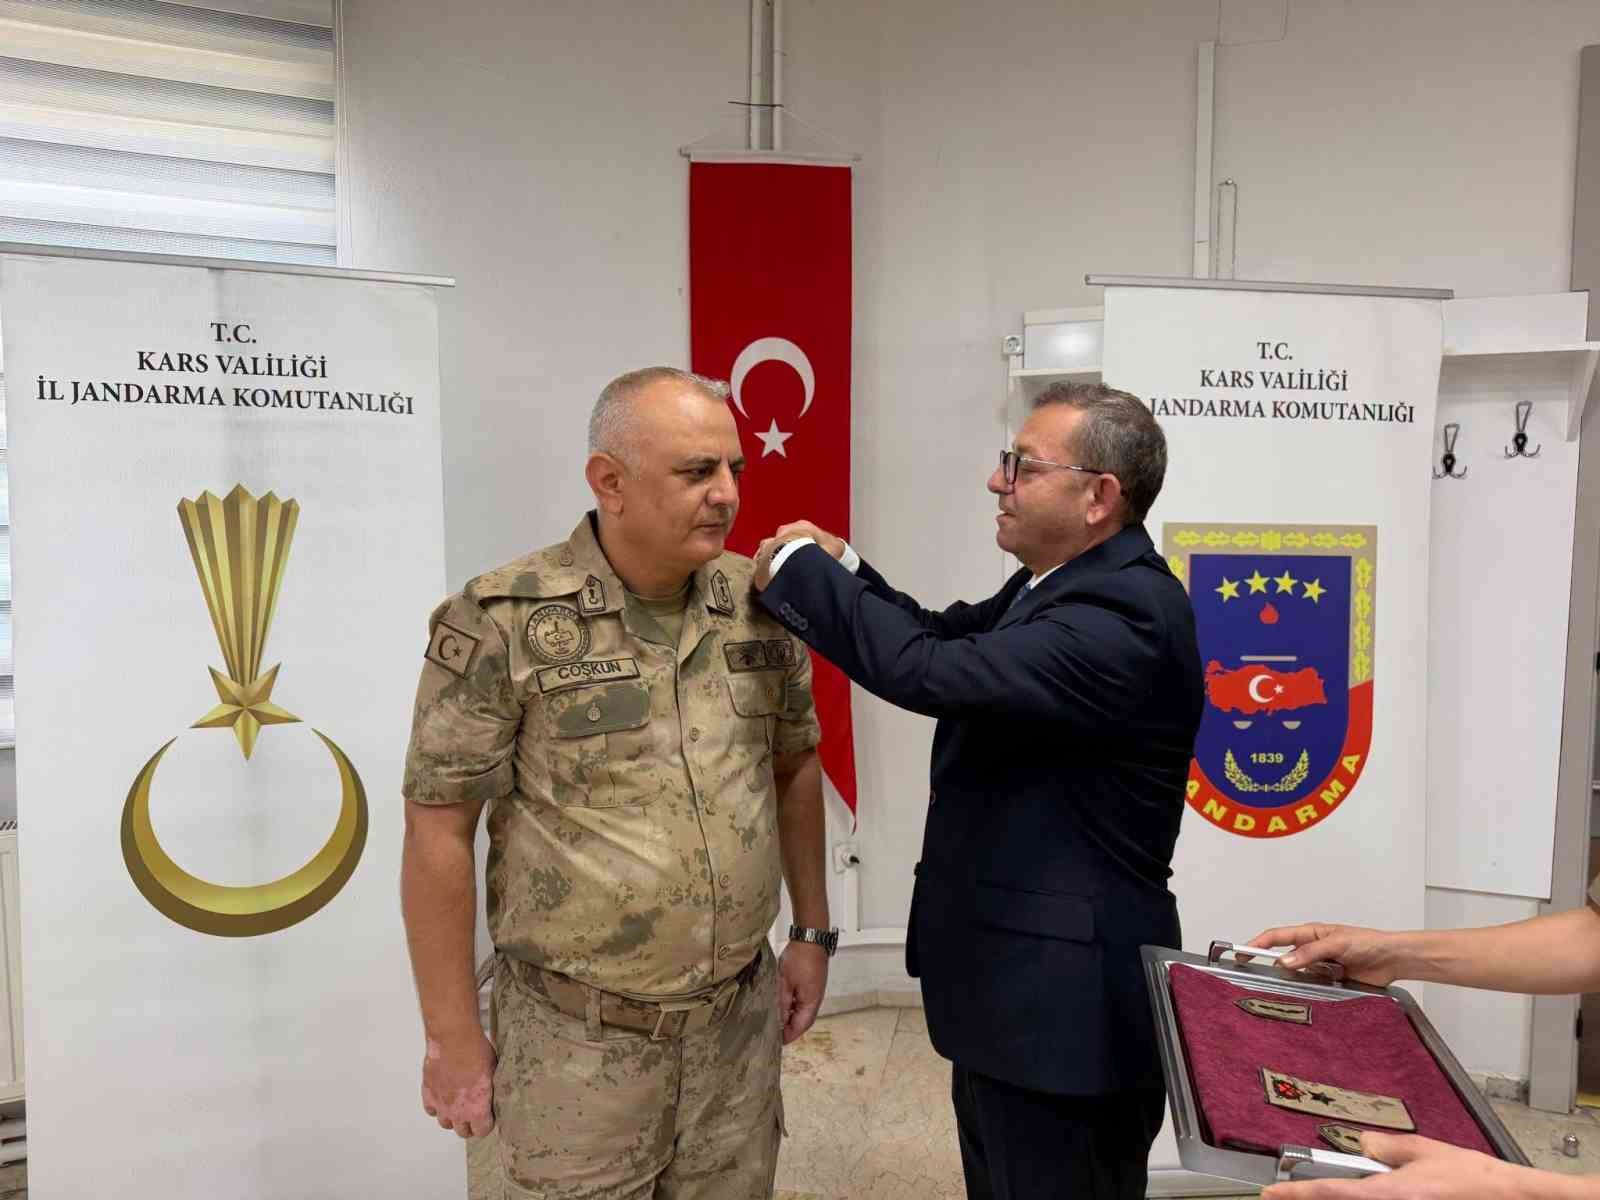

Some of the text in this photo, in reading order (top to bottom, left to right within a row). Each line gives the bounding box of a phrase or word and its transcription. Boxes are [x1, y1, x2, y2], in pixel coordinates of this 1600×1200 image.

[210, 322, 257, 344] T.C.
[1257, 342, 1293, 361] T.C.
[137, 351, 328, 379] KARS VALİLİĞİ
[1200, 368, 1349, 391] KARS VALİLİĞİ
[37, 375, 414, 415] İL JANDARMA KOMUTANLIĞI
[1150, 398, 1415, 424] JANDARMA KOMUTANLIĞI
[558, 661, 622, 680] COŞKUN
[1250, 752, 1284, 764] 1839
[1185, 754, 1360, 833] ANDARMA
